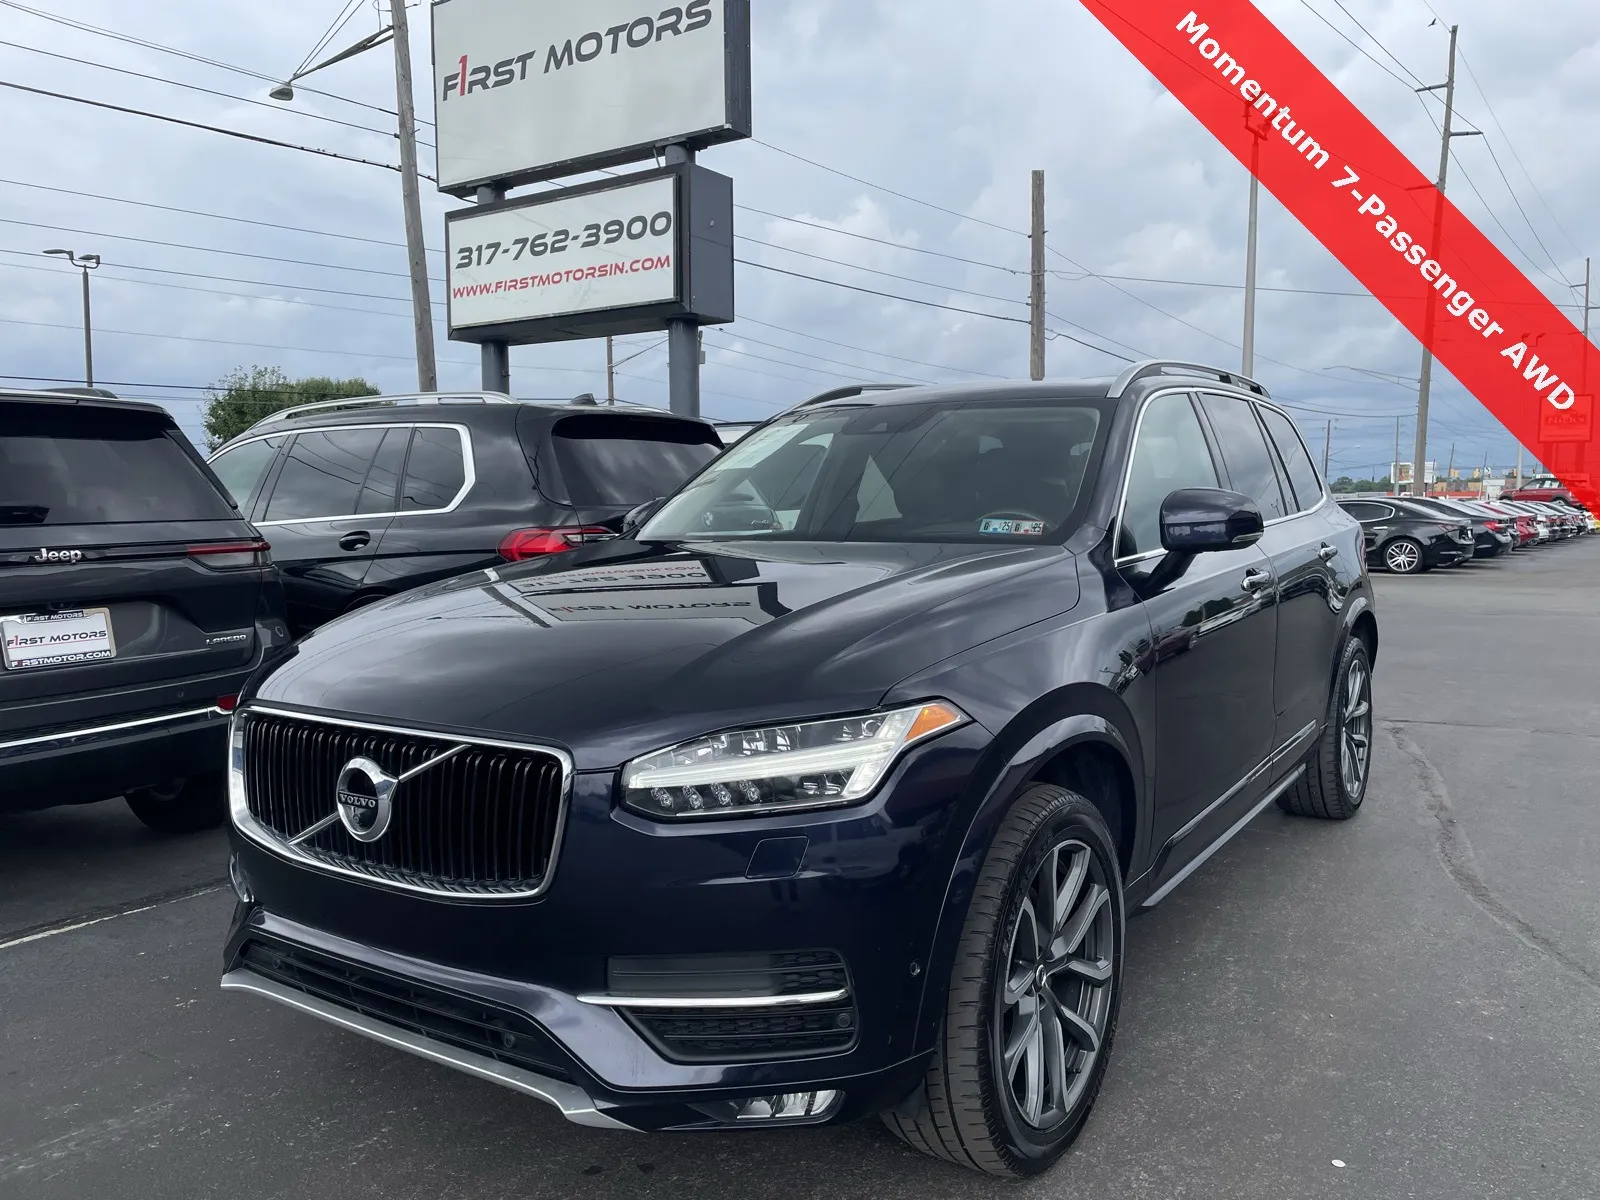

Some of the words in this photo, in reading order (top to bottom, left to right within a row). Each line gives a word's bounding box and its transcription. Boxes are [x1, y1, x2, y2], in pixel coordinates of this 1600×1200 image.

[543, 0, 712, 74] MOTORS
[455, 211, 672, 270] 317-762-3900
[452, 255, 671, 299] WWW.FIRSTMOTORSIN.COM
[34, 548, 82, 564] Jeep
[50, 612, 84, 620] MOTORS
[49, 630, 107, 642] MOTORS
[339, 793, 376, 808] VOLVO
